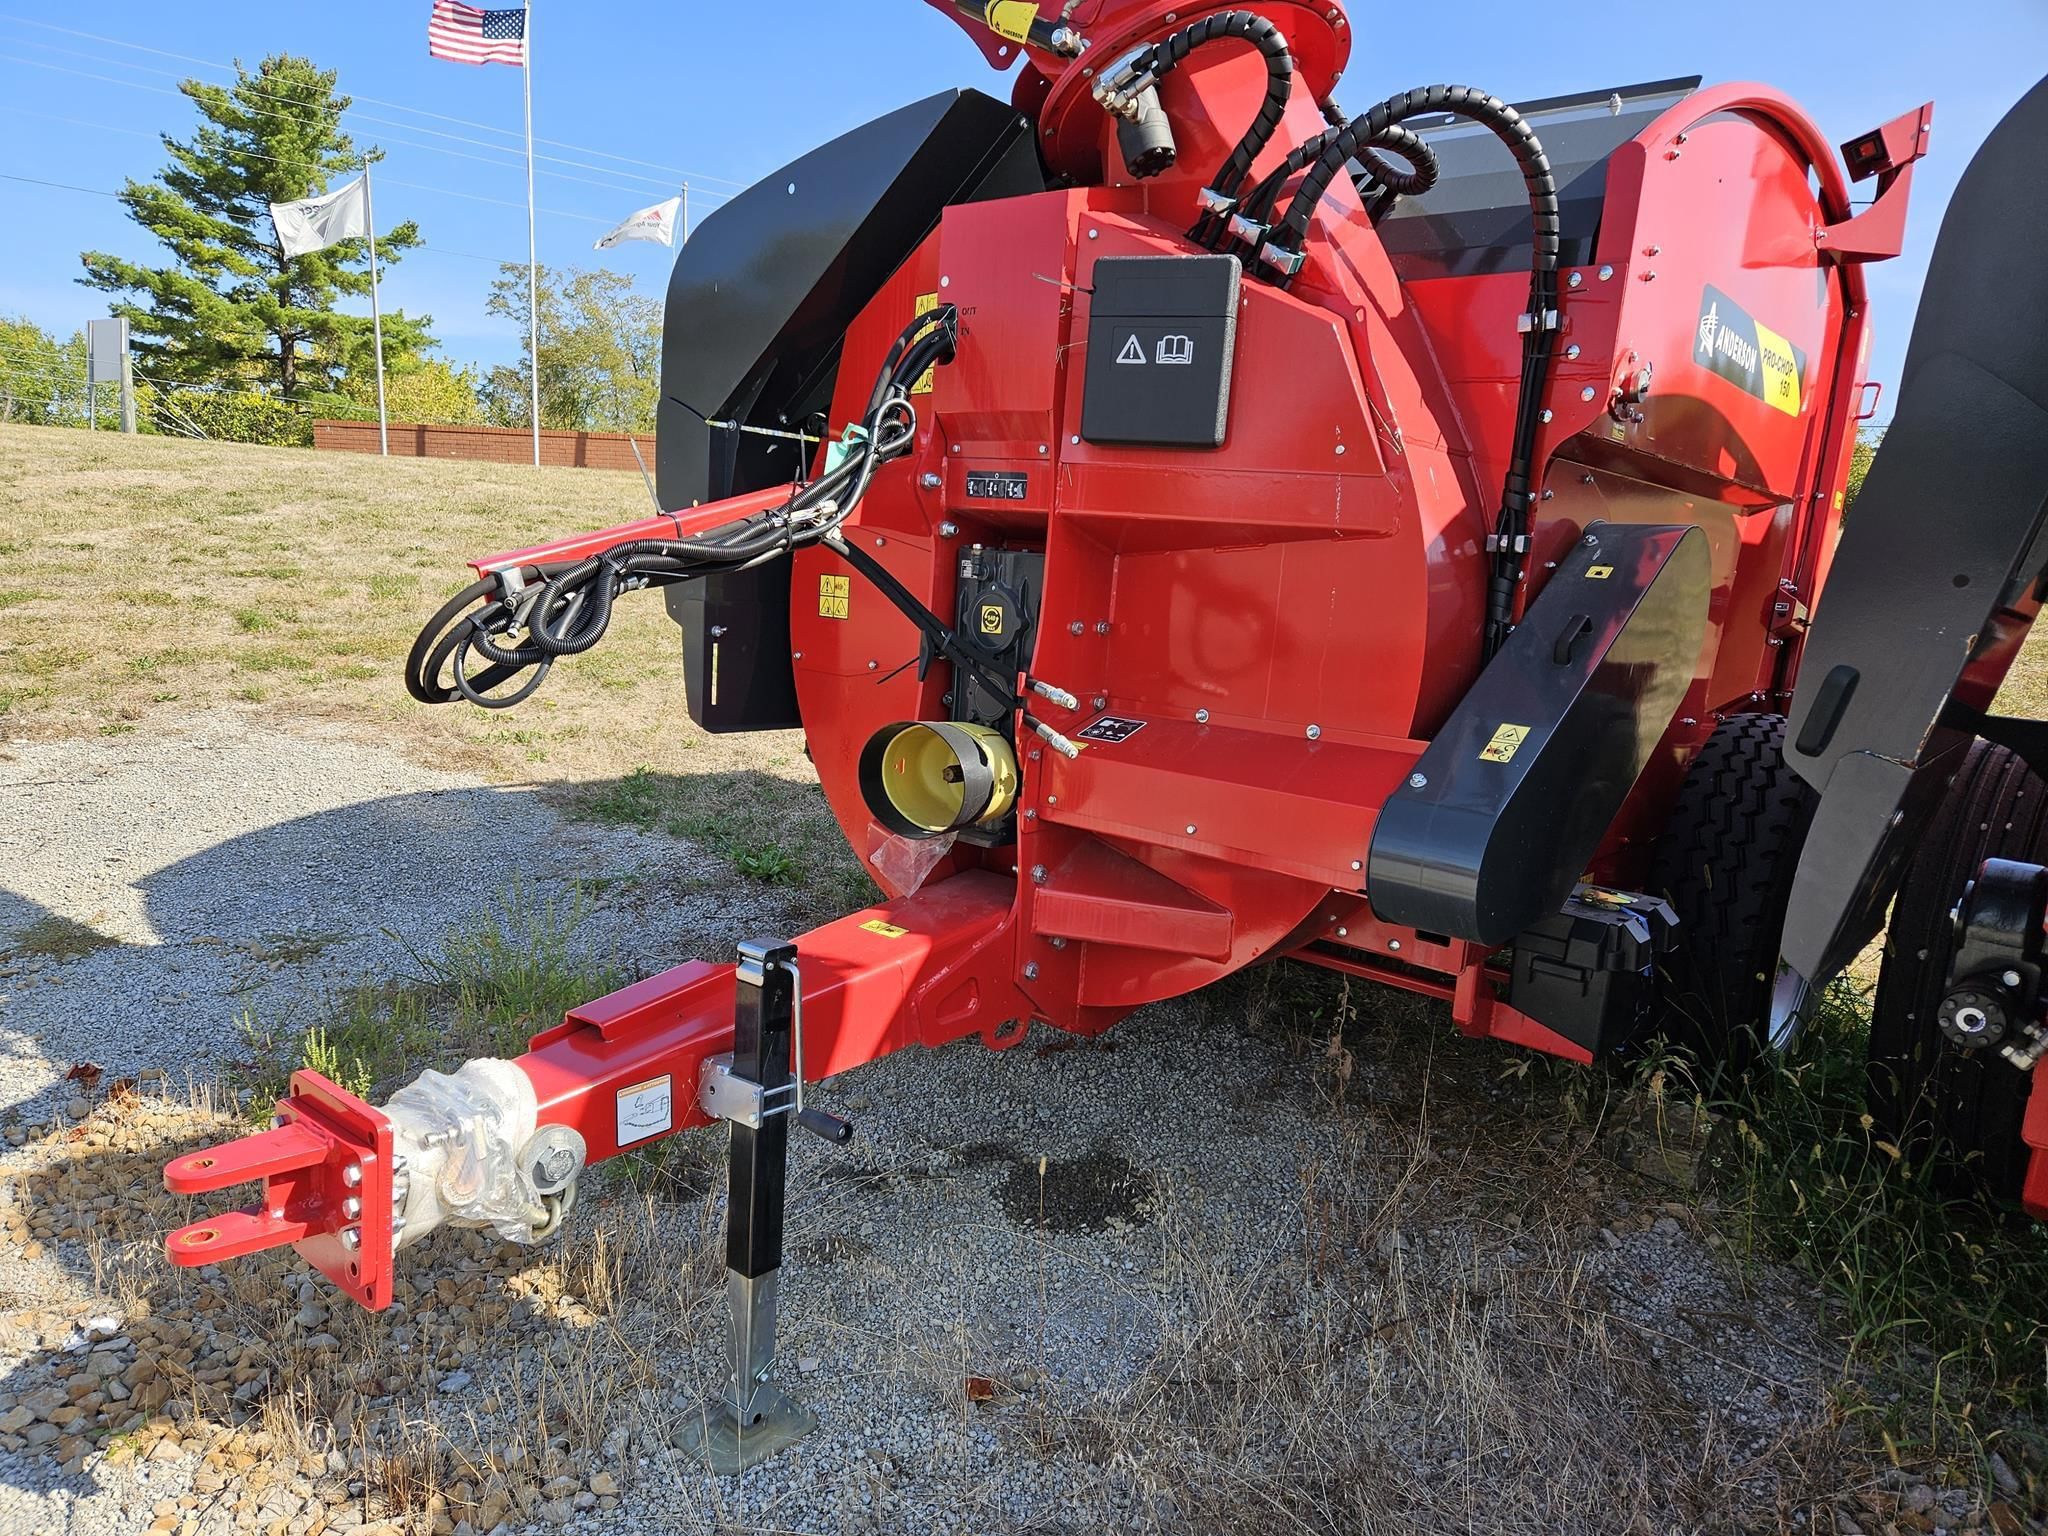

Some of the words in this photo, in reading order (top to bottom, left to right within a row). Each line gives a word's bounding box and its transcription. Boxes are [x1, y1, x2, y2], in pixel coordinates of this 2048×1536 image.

[1002, 29, 1023, 39] ANDERSON
[961, 307, 976, 316] OUT
[961, 327, 970, 336] IN
[1715, 325, 1757, 374] ANDERSON
[1763, 348, 1794, 377] PRO-CHOP
[1780, 380, 1790, 398] 150
